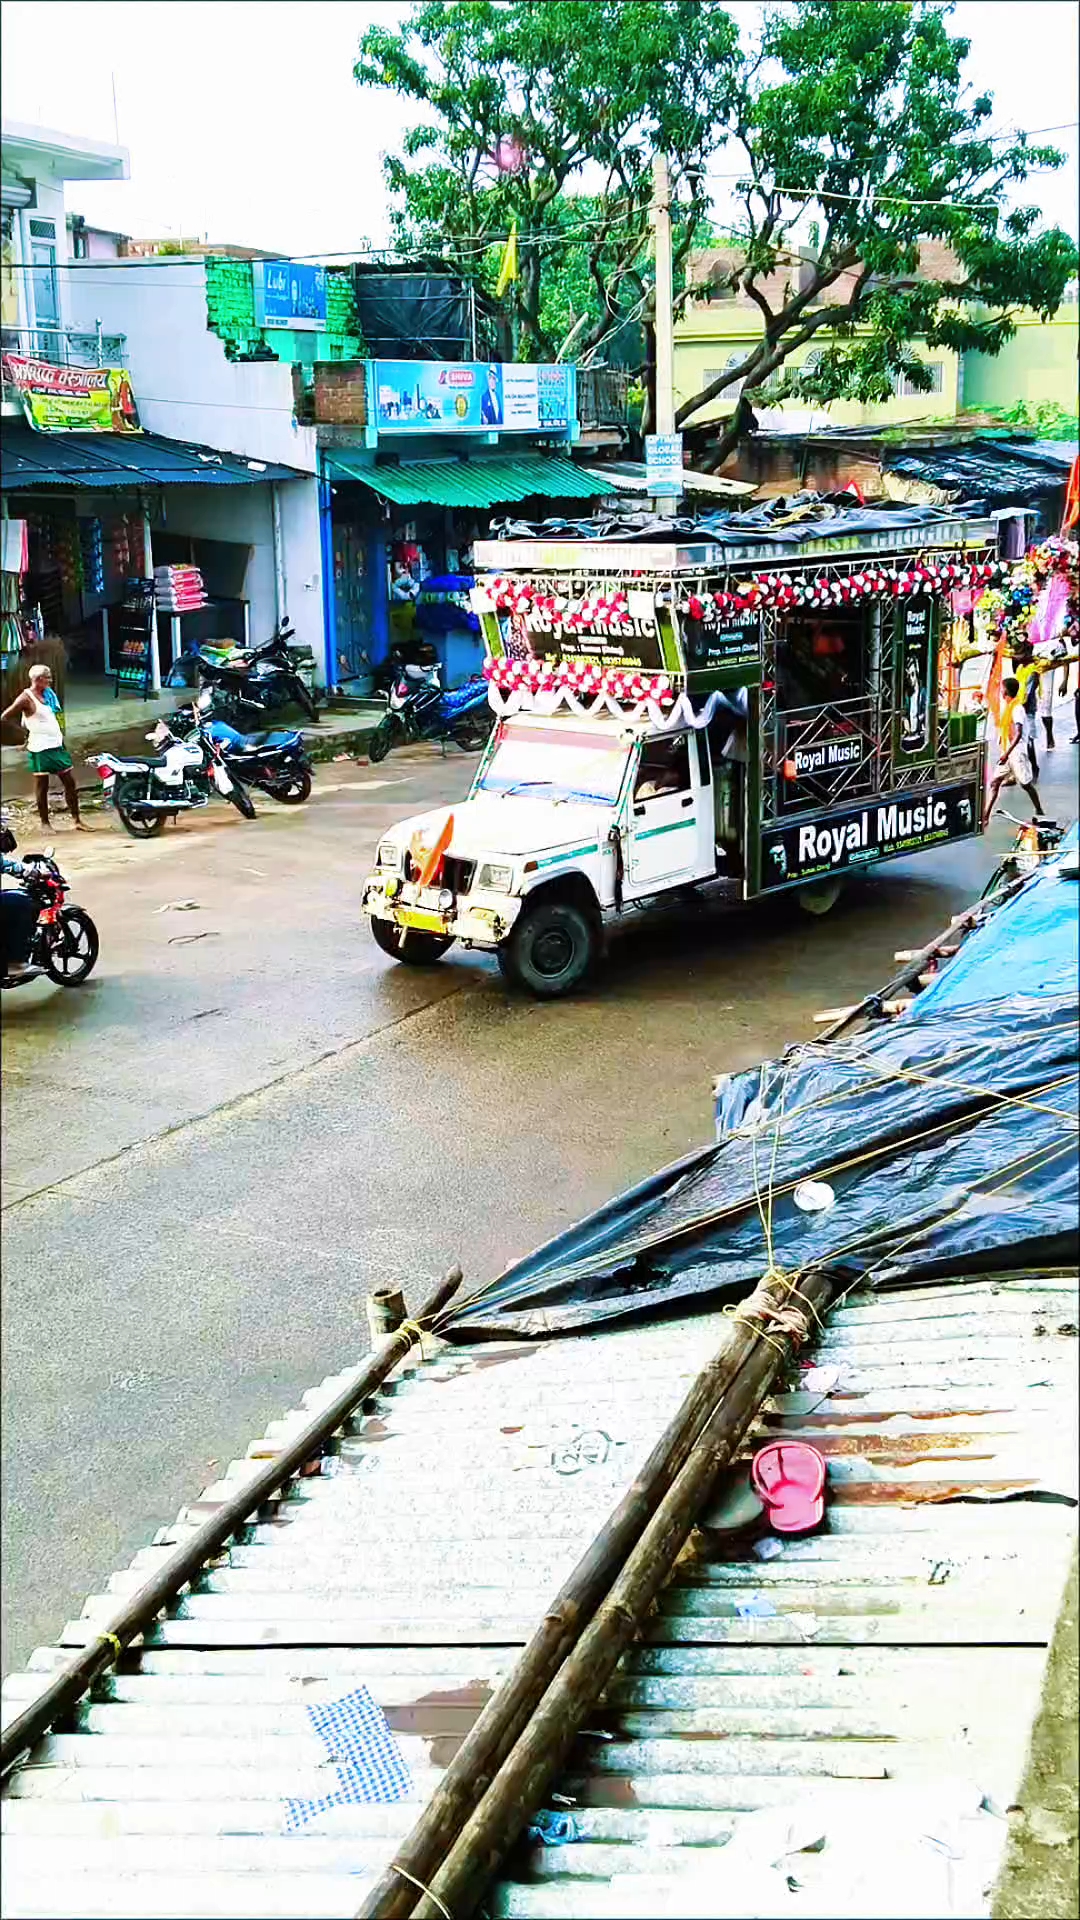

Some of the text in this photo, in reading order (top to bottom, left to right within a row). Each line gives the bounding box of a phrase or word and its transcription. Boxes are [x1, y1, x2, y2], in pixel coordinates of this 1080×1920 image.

[451, 373, 473, 381] SHIVA
[648, 455, 681, 464] SCHOOL
[907, 609, 926, 624] Royal
[906, 623, 926, 636] Music
[795, 742, 860, 772] Royal Music
[799, 811, 868, 863] Royal
[877, 796, 947, 842] Music
